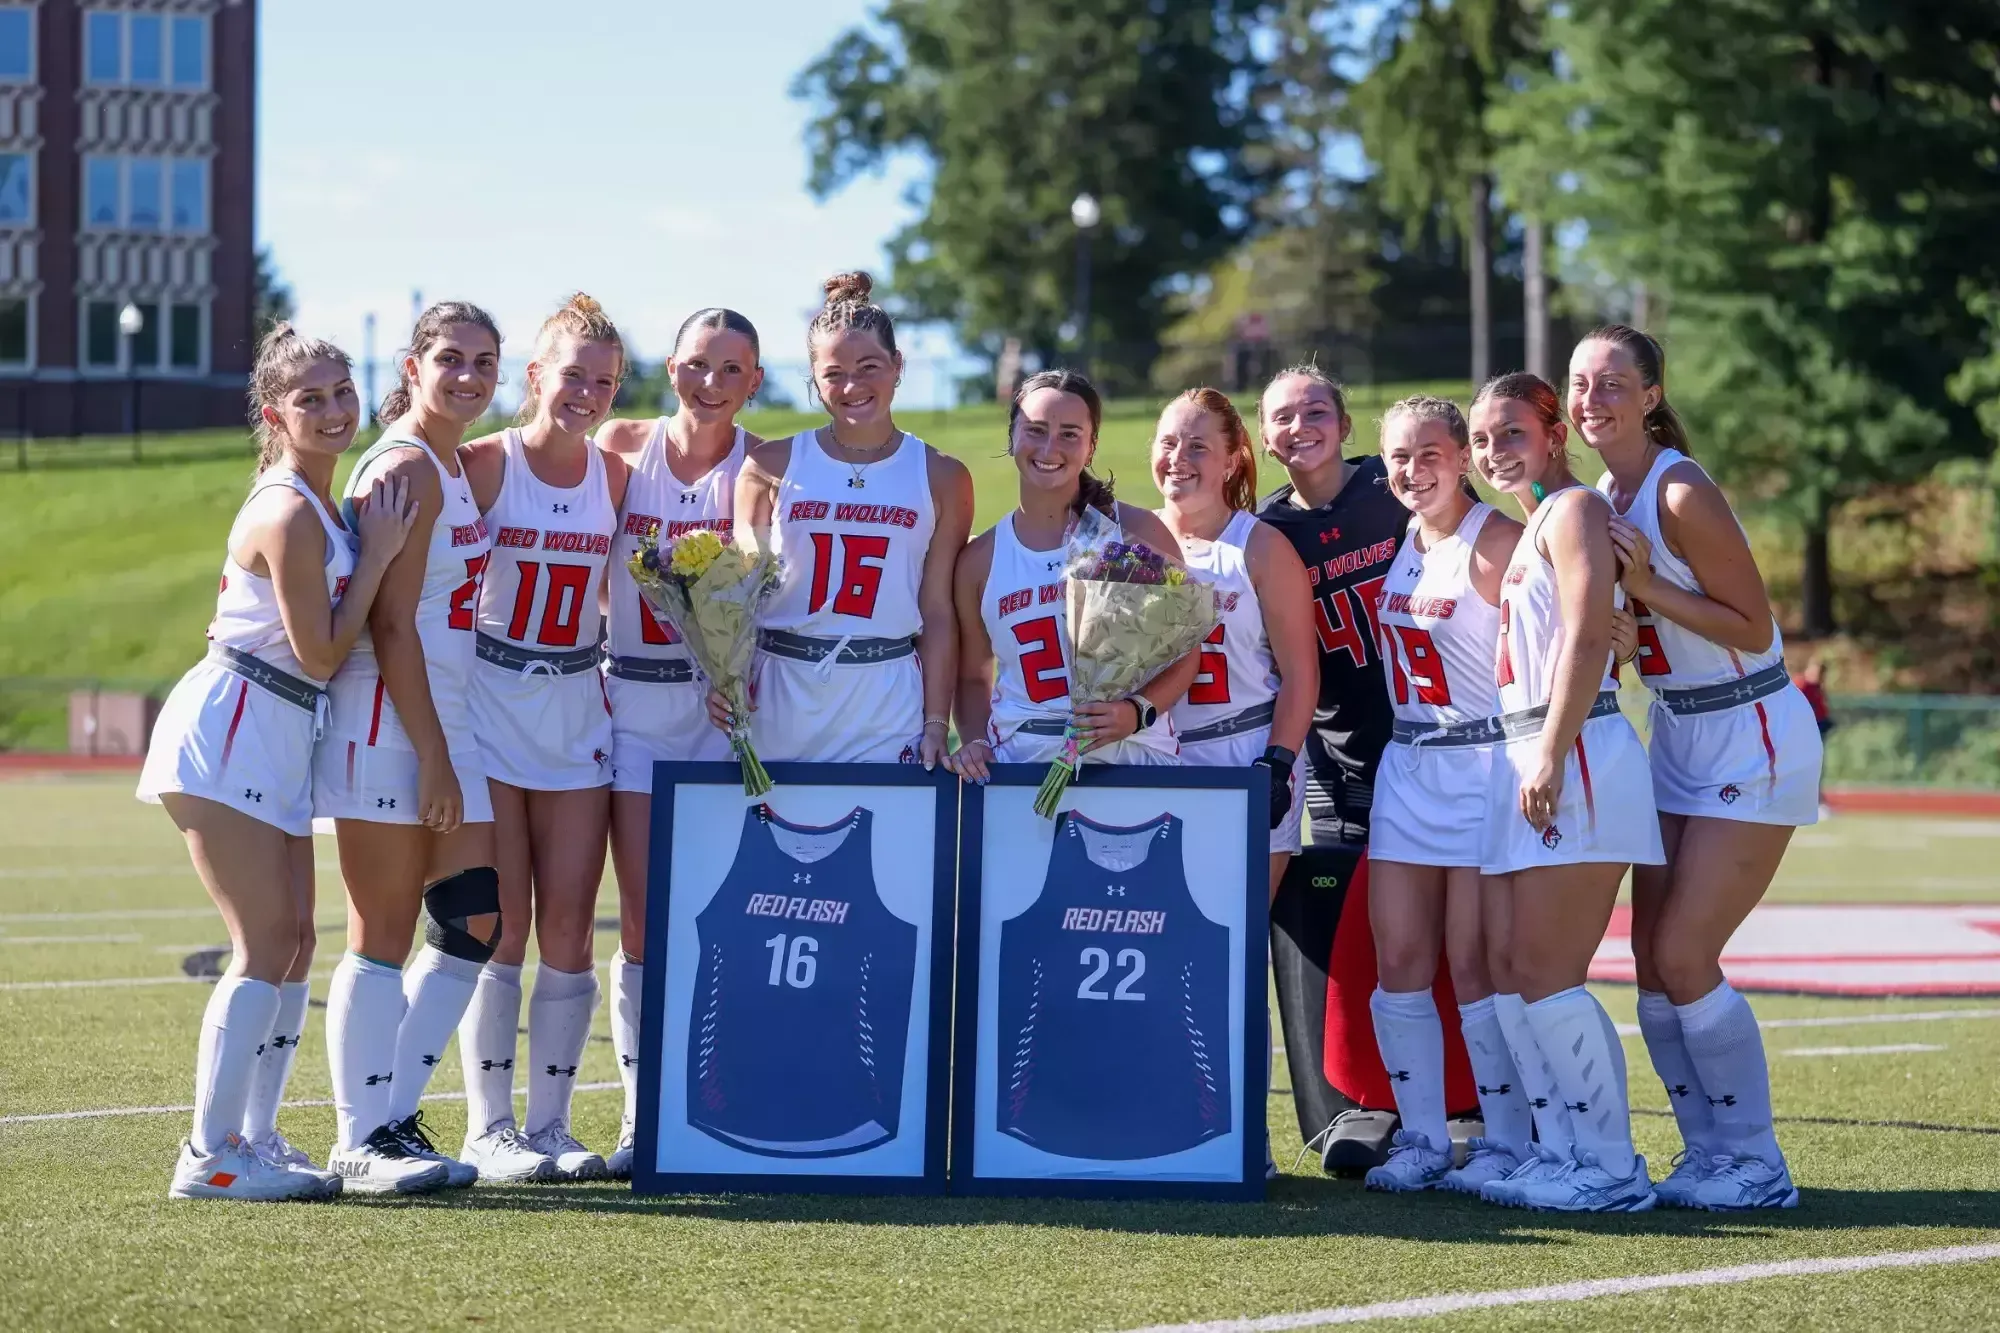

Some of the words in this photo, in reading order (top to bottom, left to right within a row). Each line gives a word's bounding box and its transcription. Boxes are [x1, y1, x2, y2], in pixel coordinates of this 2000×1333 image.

[624, 512, 663, 537] RED
[666, 518, 734, 541] WOVE
[788, 500, 831, 523] RED
[834, 502, 918, 529] WOLVES
[495, 526, 539, 549] RED
[542, 530, 610, 556] WOLVES
[1323, 537, 1397, 580] WOLVES
[808, 532, 890, 619] 16
[507, 560, 592, 647] 10
[998, 587, 1033, 620] RED
[1387, 591, 1457, 620] WOLVES
[1380, 623, 1453, 707] 19
[1311, 876, 1338, 888] OBO
[745, 893, 788, 917] RED
[784, 896, 851, 925] FLASH
[1061, 907, 1103, 931] RED
[1101, 909, 1168, 934] FLASH
[765, 932, 819, 989] 16
[1077, 946, 1146, 1001] 22
[331, 1160, 371, 1177] OSAKA
